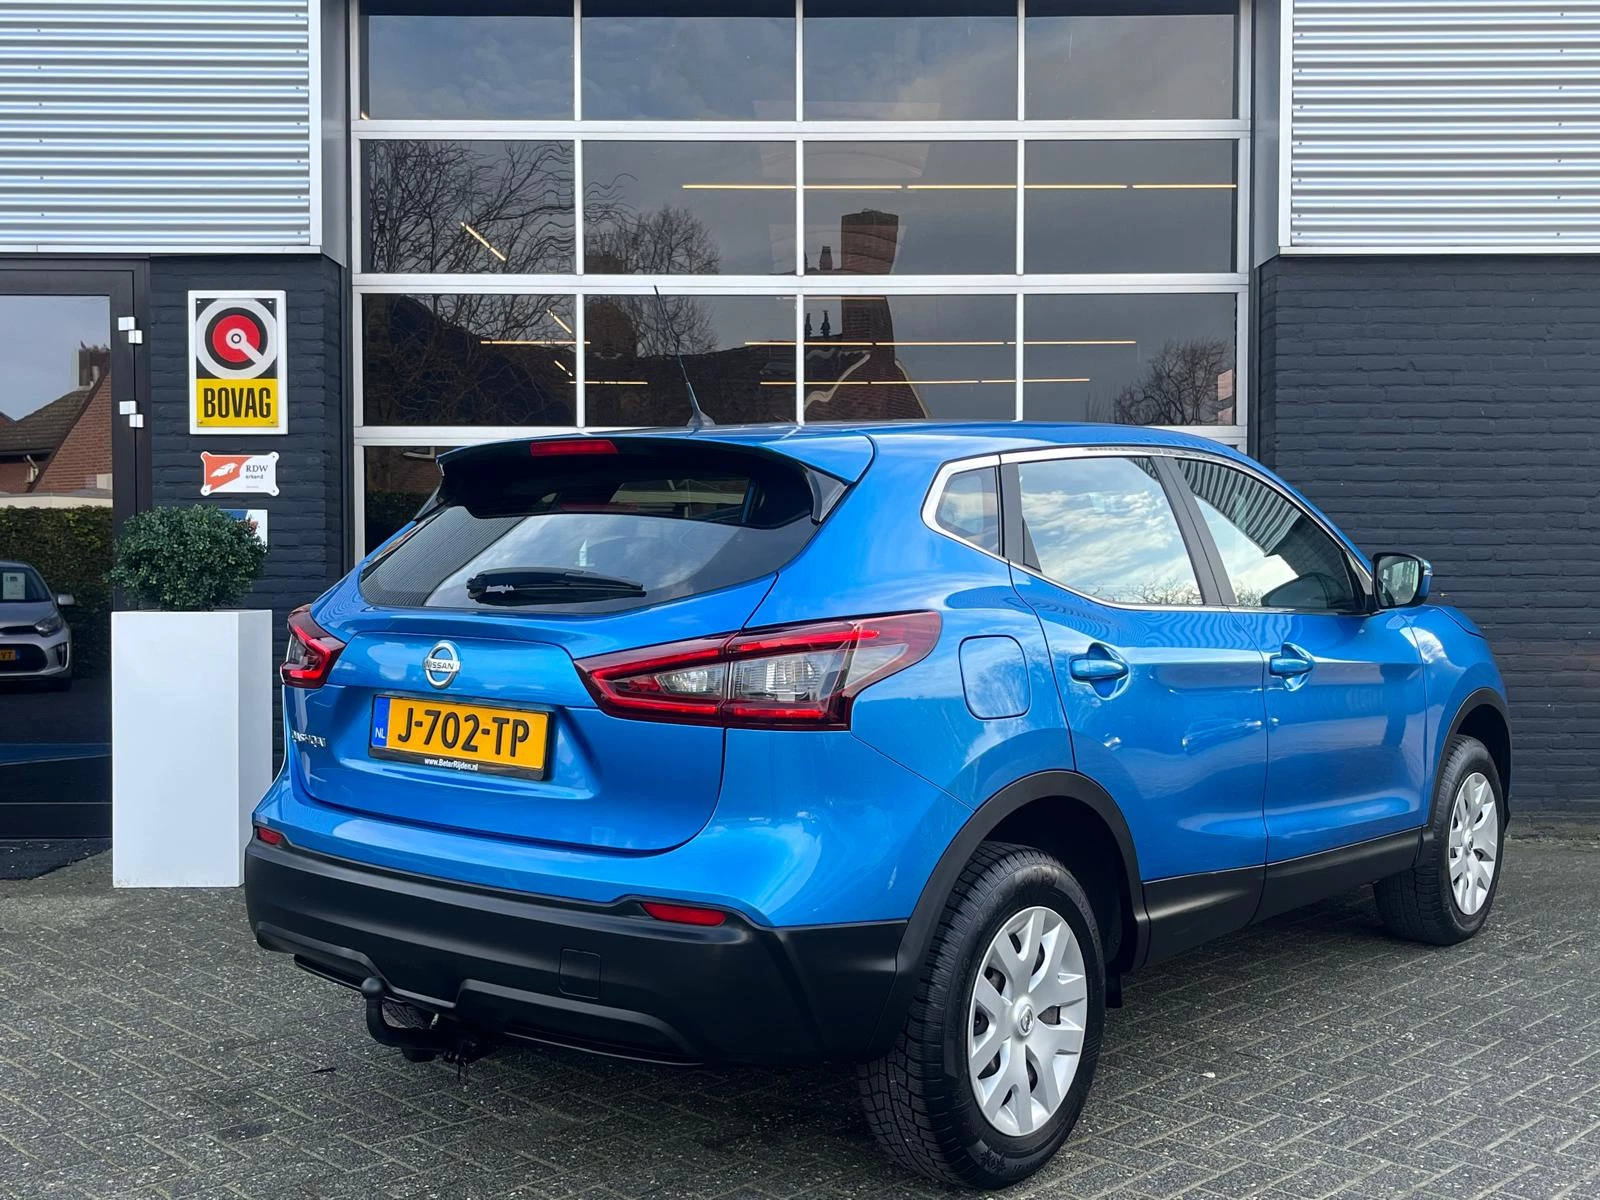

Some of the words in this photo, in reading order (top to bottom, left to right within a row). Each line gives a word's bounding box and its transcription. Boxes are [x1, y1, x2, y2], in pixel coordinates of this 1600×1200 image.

[203, 387, 271, 418] BOVAG
[246, 464, 269, 473] RDW
[425, 659, 454, 670] NISSAN
[375, 727, 386, 739] NL
[397, 707, 530, 757] J-702-TP
[424, 758, 479, 771] www.BeterRijden.nl
